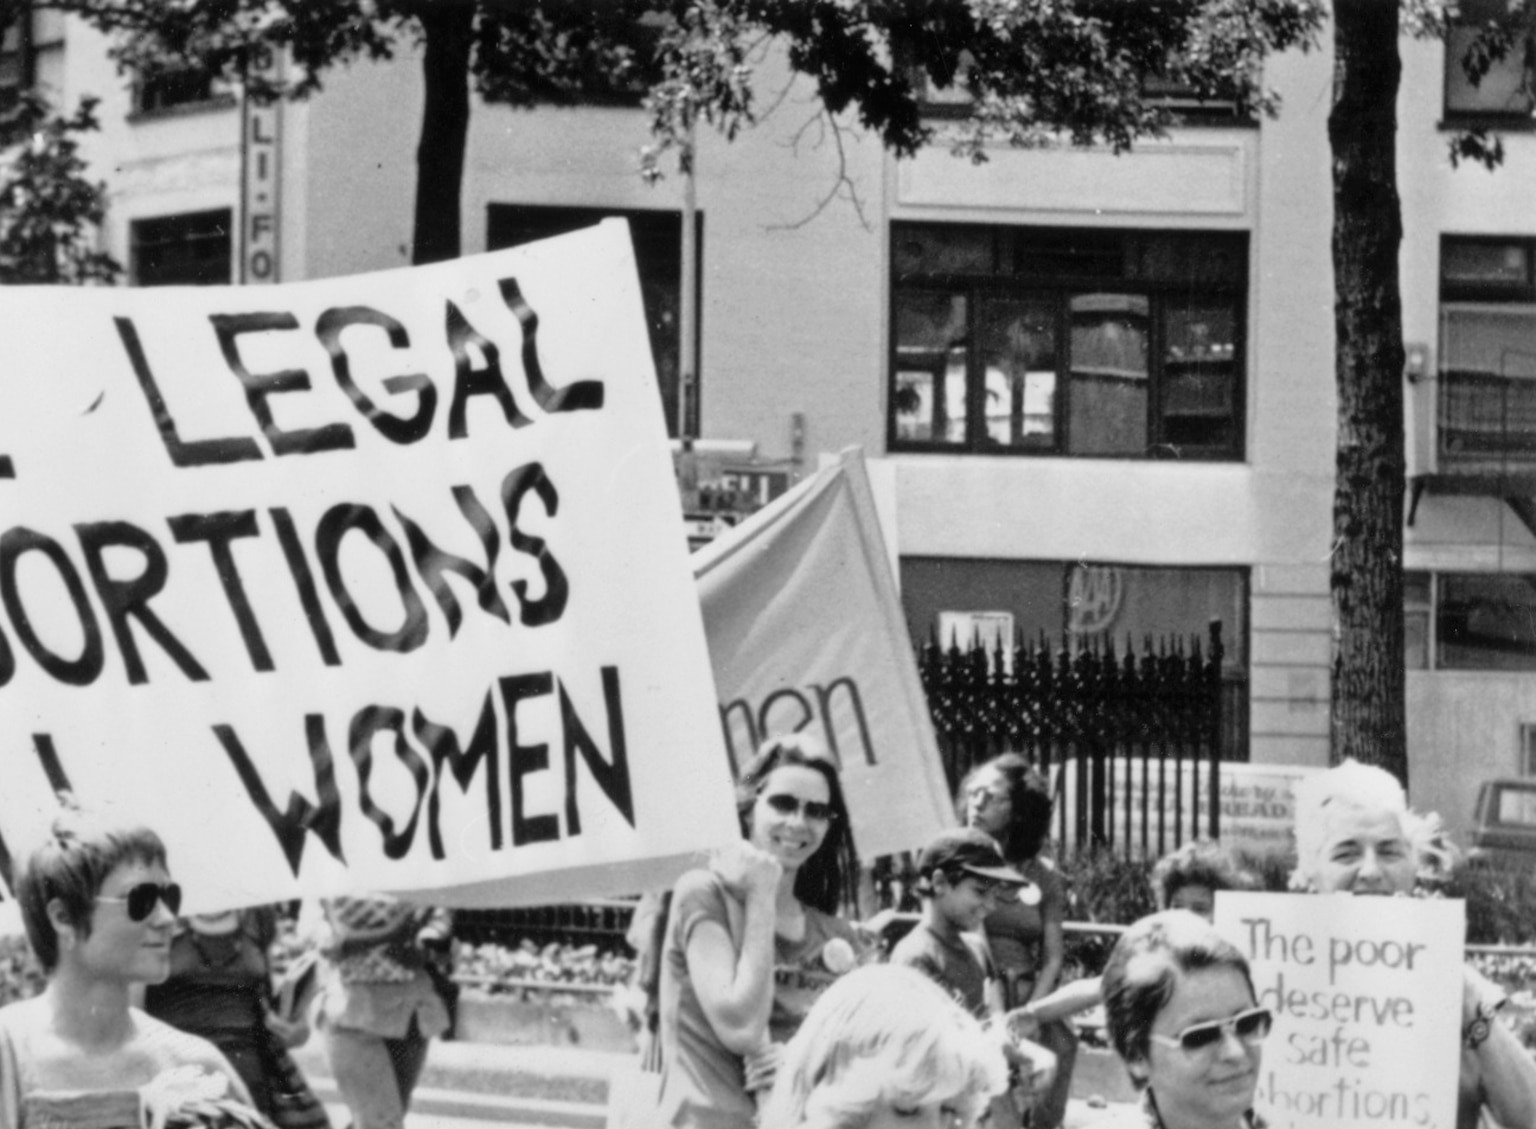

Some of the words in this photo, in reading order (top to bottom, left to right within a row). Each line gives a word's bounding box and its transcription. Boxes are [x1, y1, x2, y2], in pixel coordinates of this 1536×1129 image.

[112, 276, 604, 467] LEGAL
[209, 666, 636, 877] WOMEN
[1241, 917, 1315, 965] The
[1329, 936, 1427, 986] poor
[1260, 972, 1415, 1028] deserve
[1286, 1026, 1371, 1068] safe
